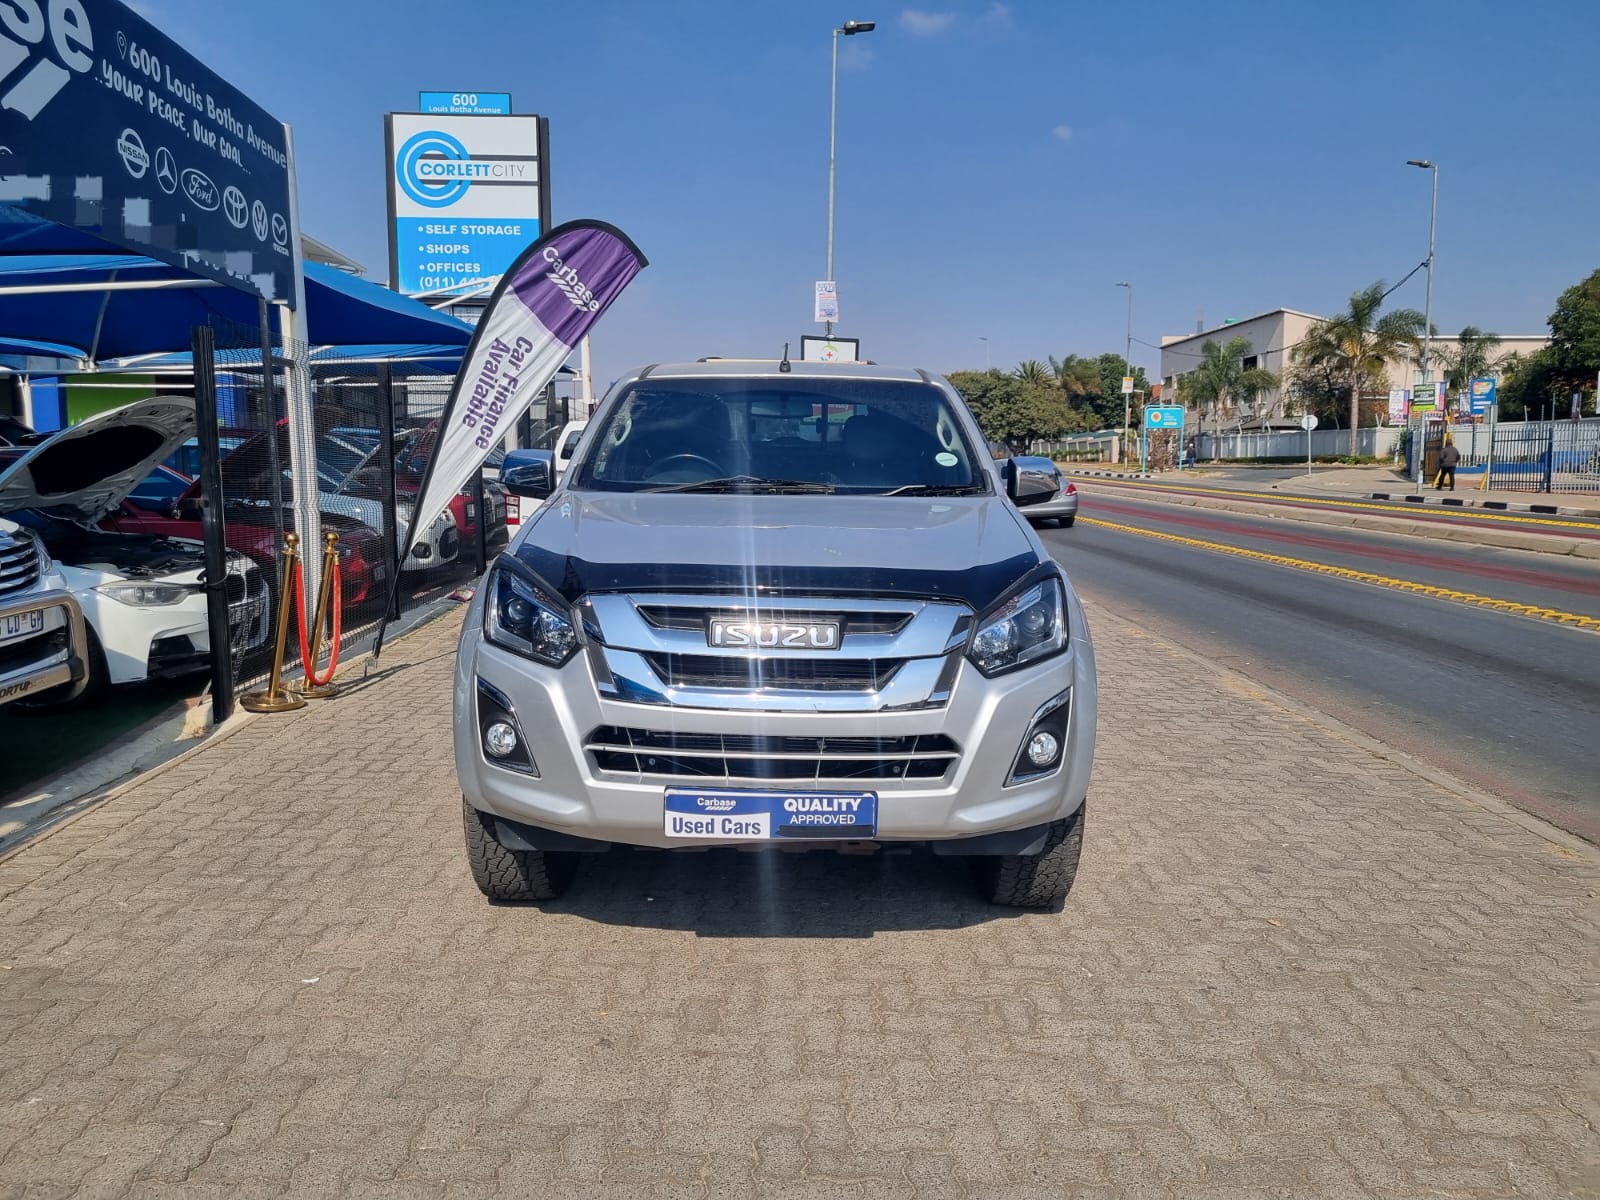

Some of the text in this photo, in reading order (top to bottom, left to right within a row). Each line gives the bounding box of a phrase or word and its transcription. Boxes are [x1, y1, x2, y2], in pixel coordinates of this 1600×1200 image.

[129, 42, 287, 169] 600 Louis Botha Avenue
[452, 94, 478, 106] 600
[428, 105, 448, 113] Louis
[474, 106, 501, 114] Avenue
[193, 119, 217, 150] OUR
[119, 142, 149, 166] NISSAN
[188, 173, 213, 204] Ford
[426, 224, 521, 236] SELF STORAGE
[426, 244, 470, 255] SHOPS
[427, 262, 480, 273] OFFICES
[420, 276, 455, 290] (011)
[542, 246, 600, 312] Carbase
[462, 337, 511, 429] Available
[475, 336, 533, 450] Car Finance
[714, 624, 834, 646] ISUZU
[697, 797, 736, 808] Carbase
[784, 798, 861, 812] QUALITY
[672, 817, 761, 835] Used Cars
[790, 814, 856, 825] APPROVED
